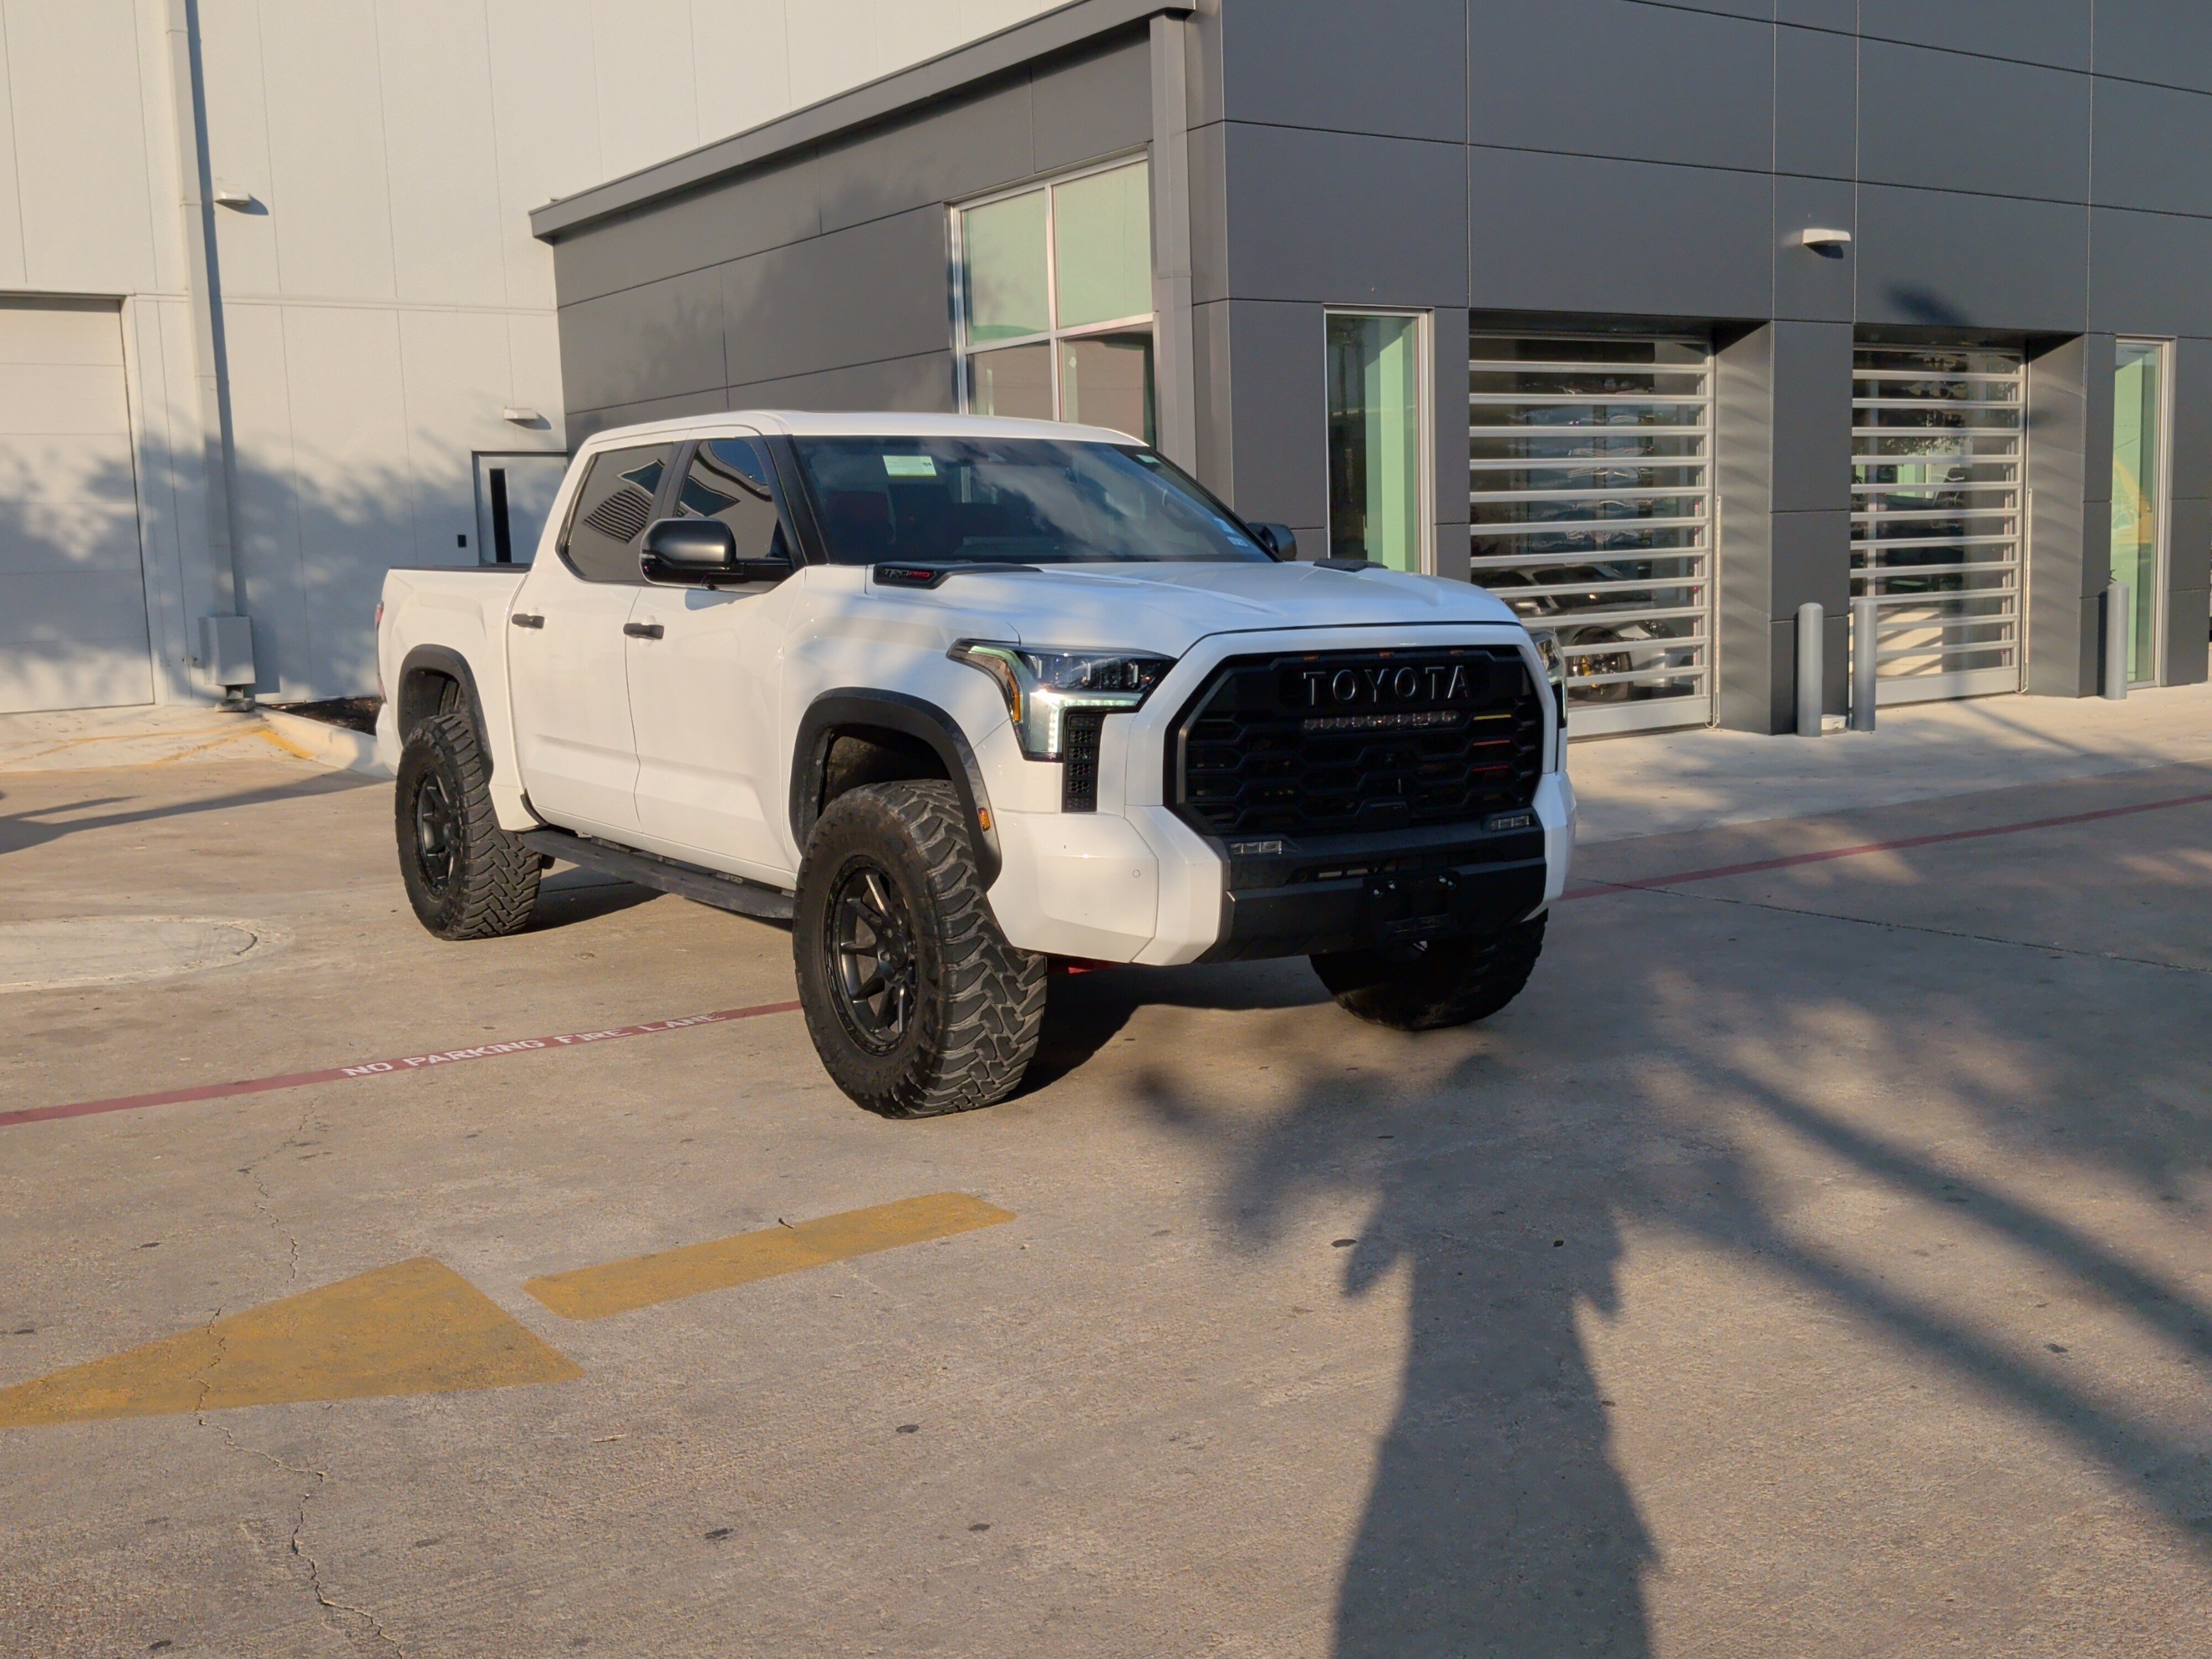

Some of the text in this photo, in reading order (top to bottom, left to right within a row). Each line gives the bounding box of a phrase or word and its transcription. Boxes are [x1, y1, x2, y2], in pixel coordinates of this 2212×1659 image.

[1303, 665, 1470, 706] TOYOTA
[341, 1014, 726, 1076] NO PARKING FIRE LANE
